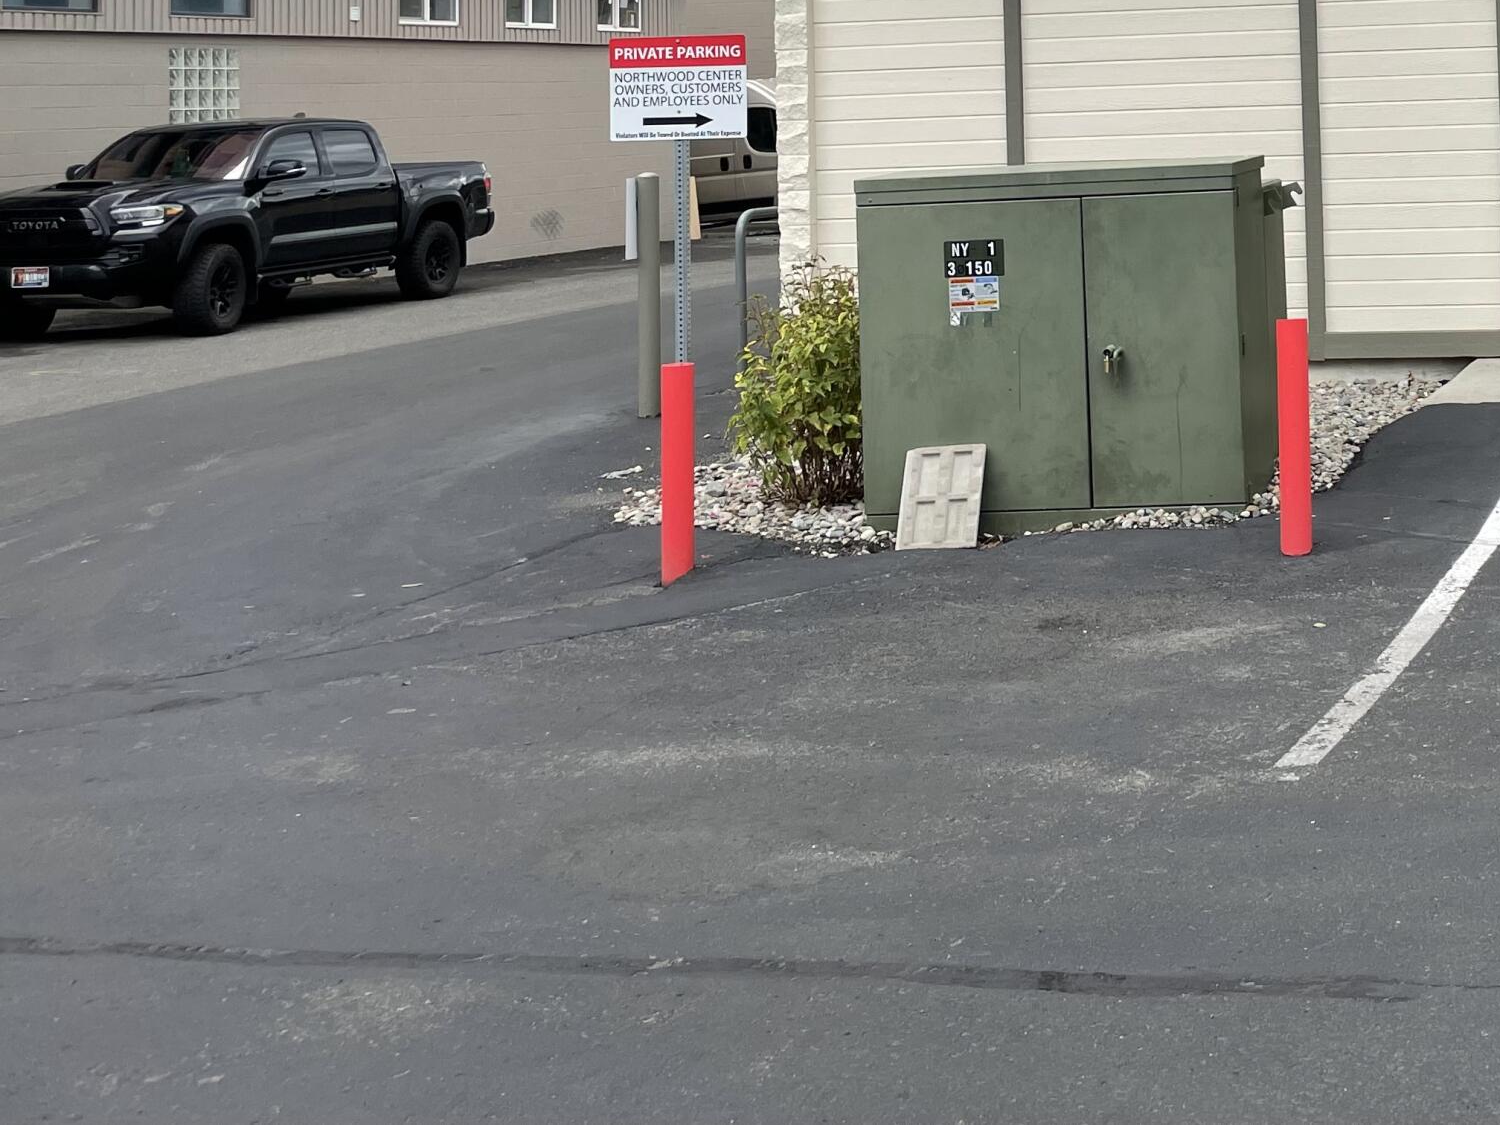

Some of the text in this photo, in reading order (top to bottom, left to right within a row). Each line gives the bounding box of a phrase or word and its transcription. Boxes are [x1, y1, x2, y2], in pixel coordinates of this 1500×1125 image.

[614, 44, 741, 60] PRIVATE PARKING
[614, 69, 742, 83] NORTHWOOD CENTER
[614, 82, 742, 96] OWNERS, CUSTOMERS
[614, 94, 744, 108] AND EMPLOYEES ONLY
[12, 221, 59, 230] TOYOTA
[951, 241, 995, 257] NY 1
[947, 260, 992, 276] 3 150
